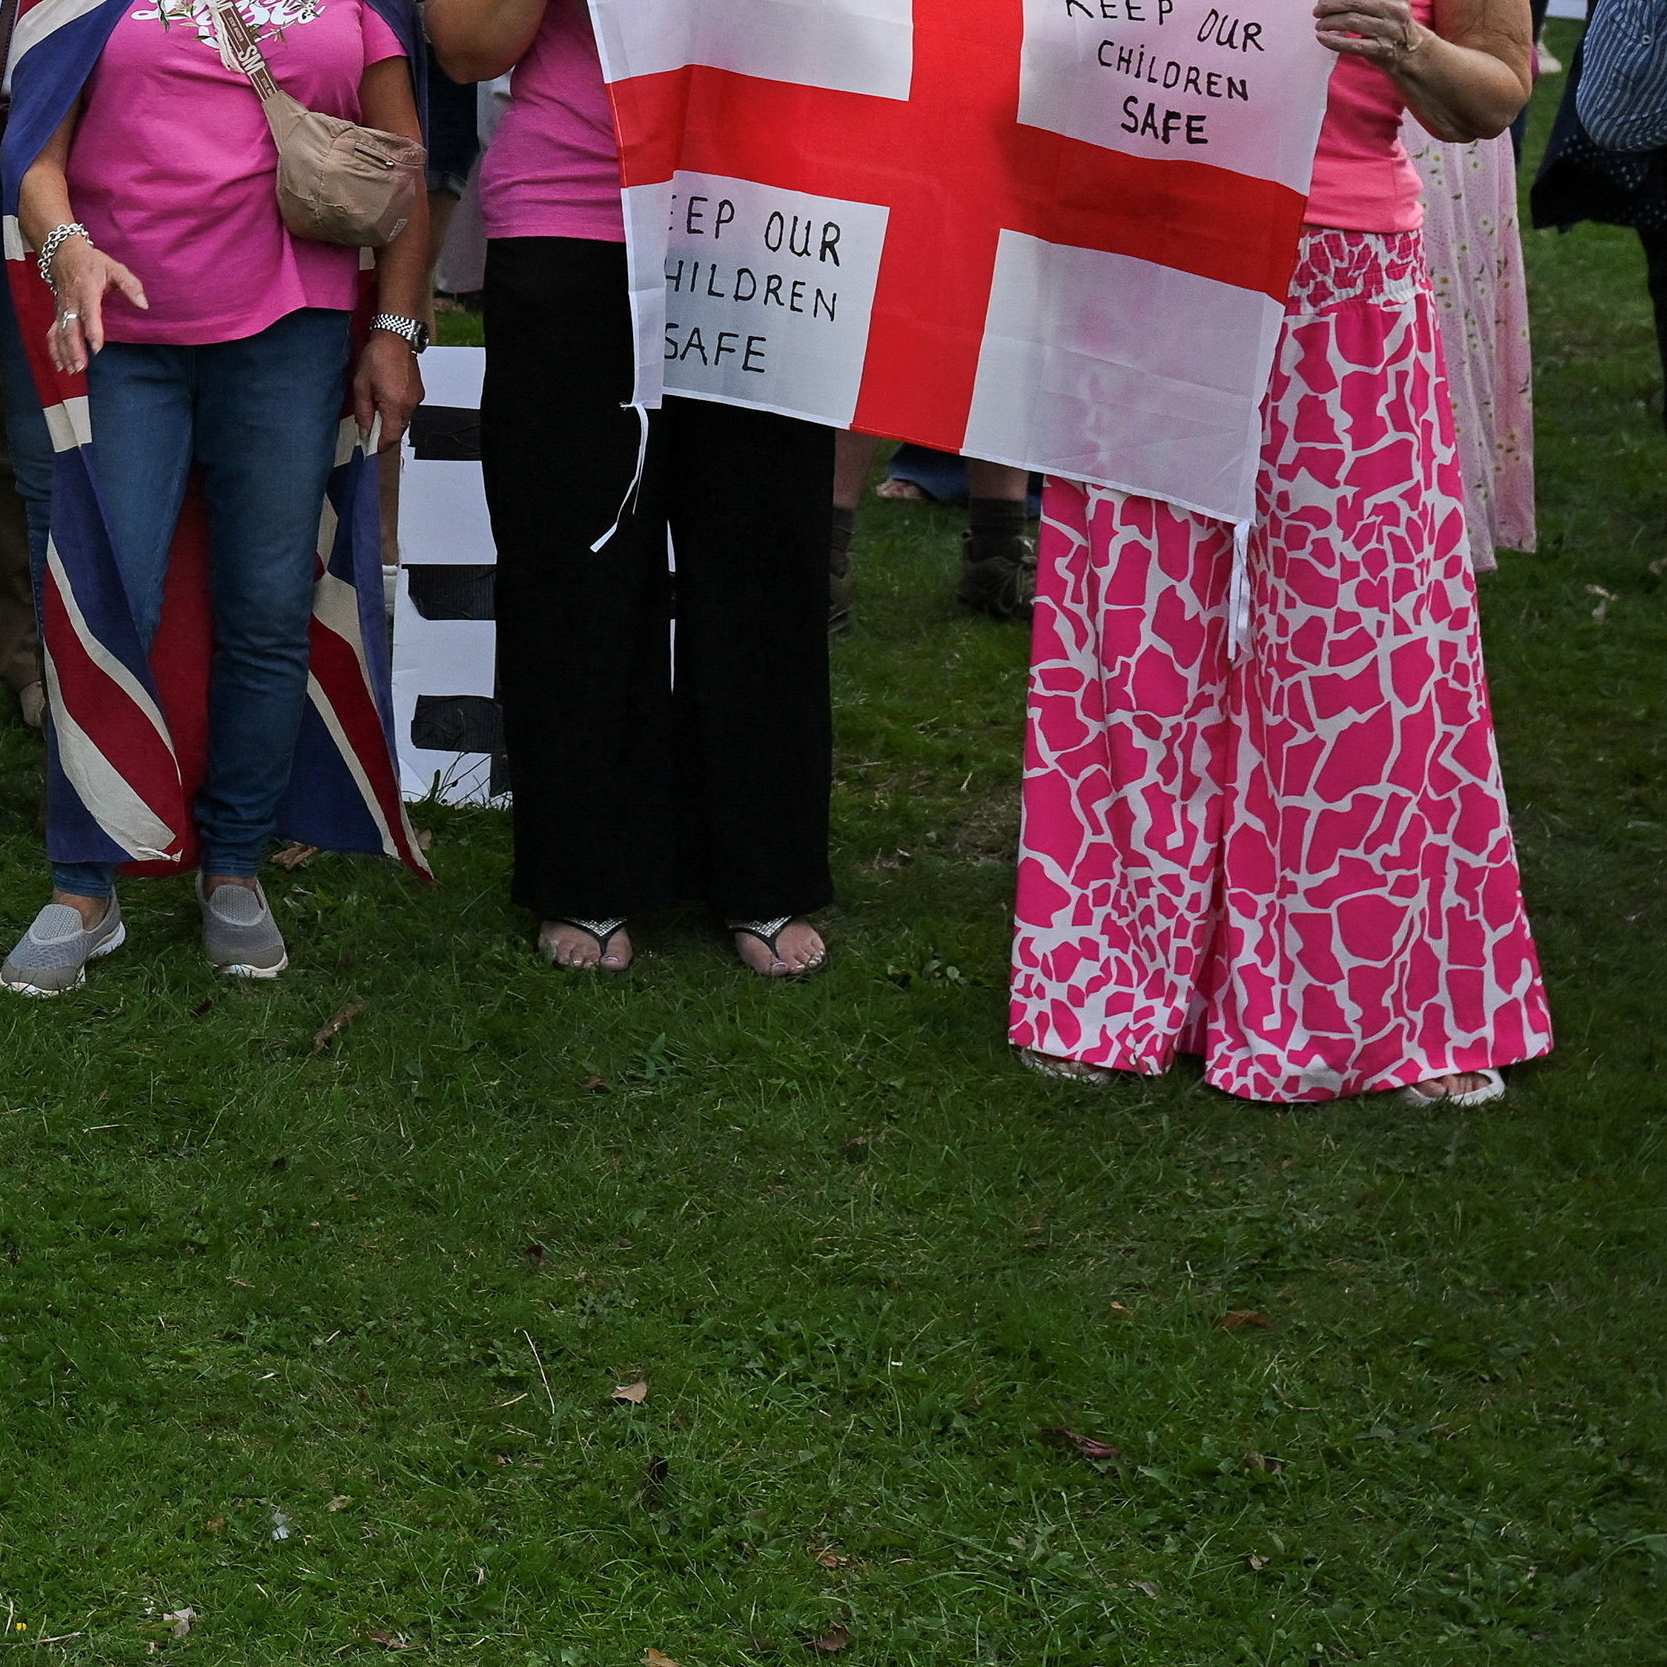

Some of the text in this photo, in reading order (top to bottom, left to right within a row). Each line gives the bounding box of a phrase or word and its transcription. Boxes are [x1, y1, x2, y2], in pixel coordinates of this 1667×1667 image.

[1197, 8, 1265, 52] OUR
[238, 44, 266, 76] SM
[1121, 95, 1208, 145] SAFE
[666, 194, 841, 268] EP OUR
[665, 257, 838, 322] HILDREN
[664, 322, 767, 374] SAFE
